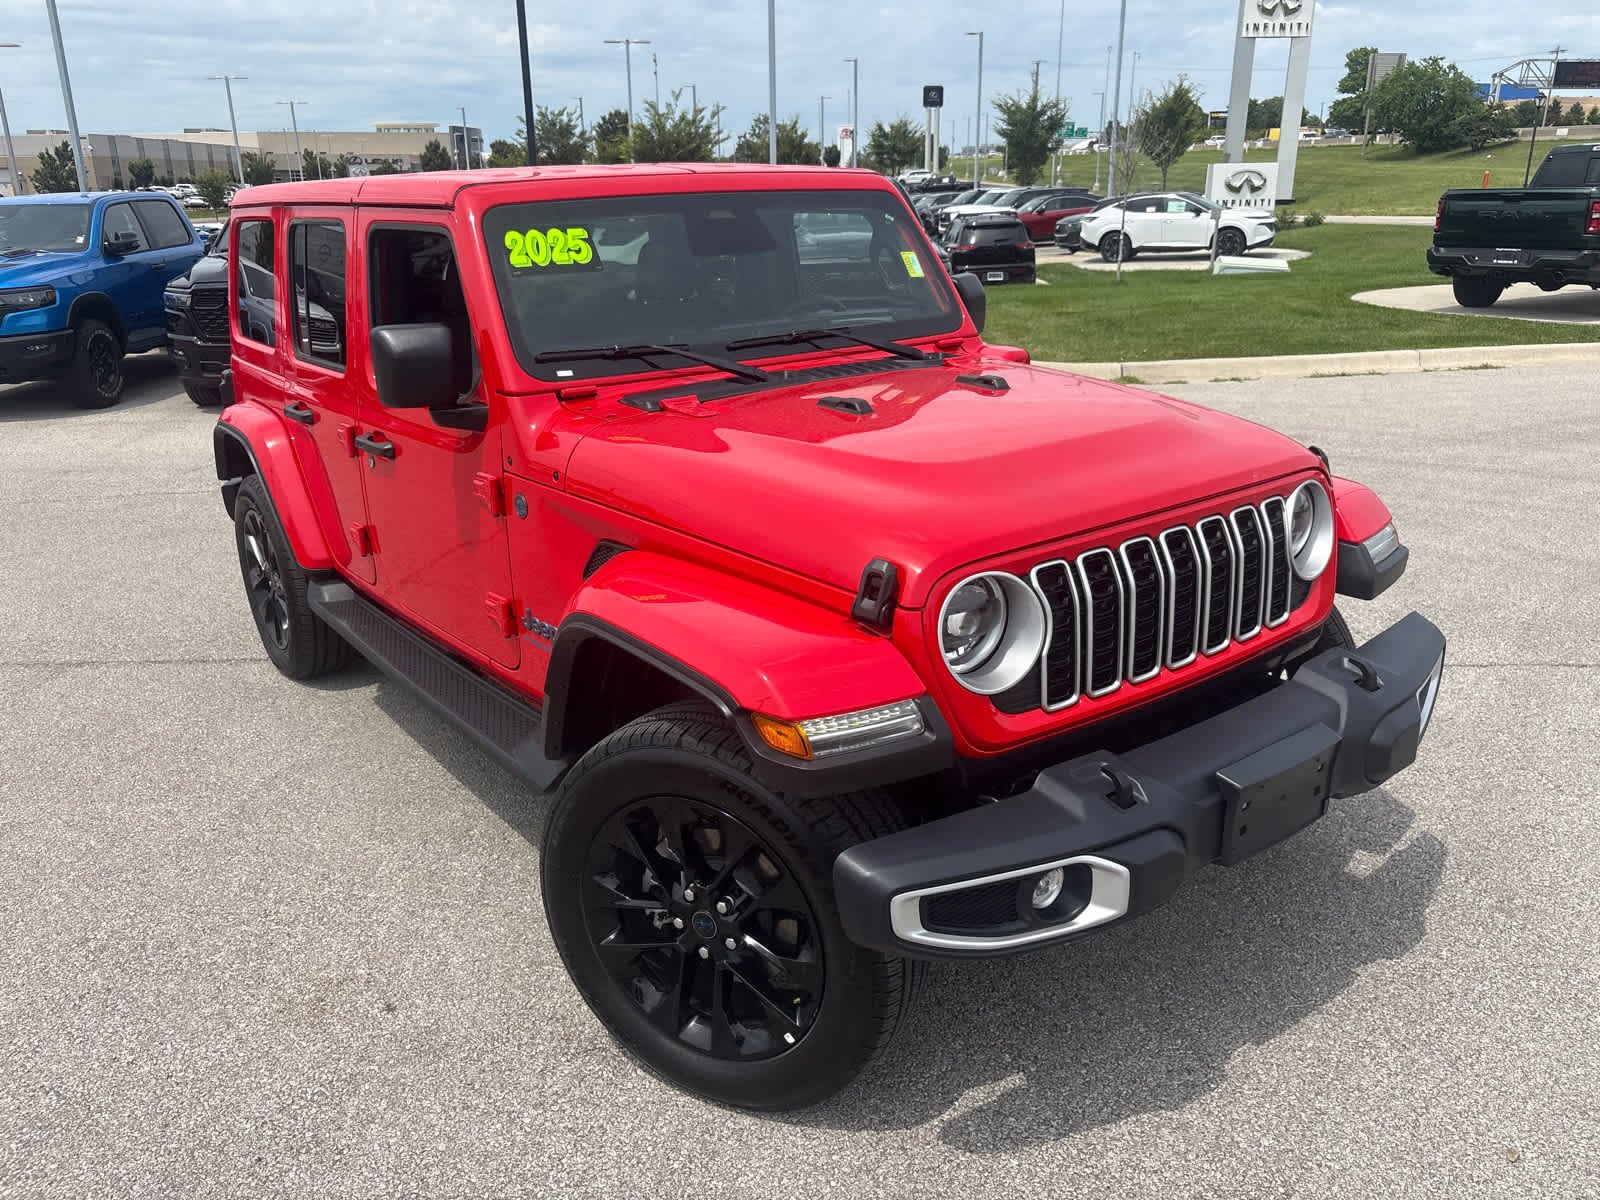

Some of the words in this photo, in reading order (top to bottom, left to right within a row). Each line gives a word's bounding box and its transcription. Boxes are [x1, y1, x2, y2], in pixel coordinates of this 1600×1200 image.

[1245, 22, 1310, 33] INFINITI
[1216, 198, 1271, 208] INFINITI
[504, 228, 593, 268] 2025
[520, 607, 558, 640] Jeep
